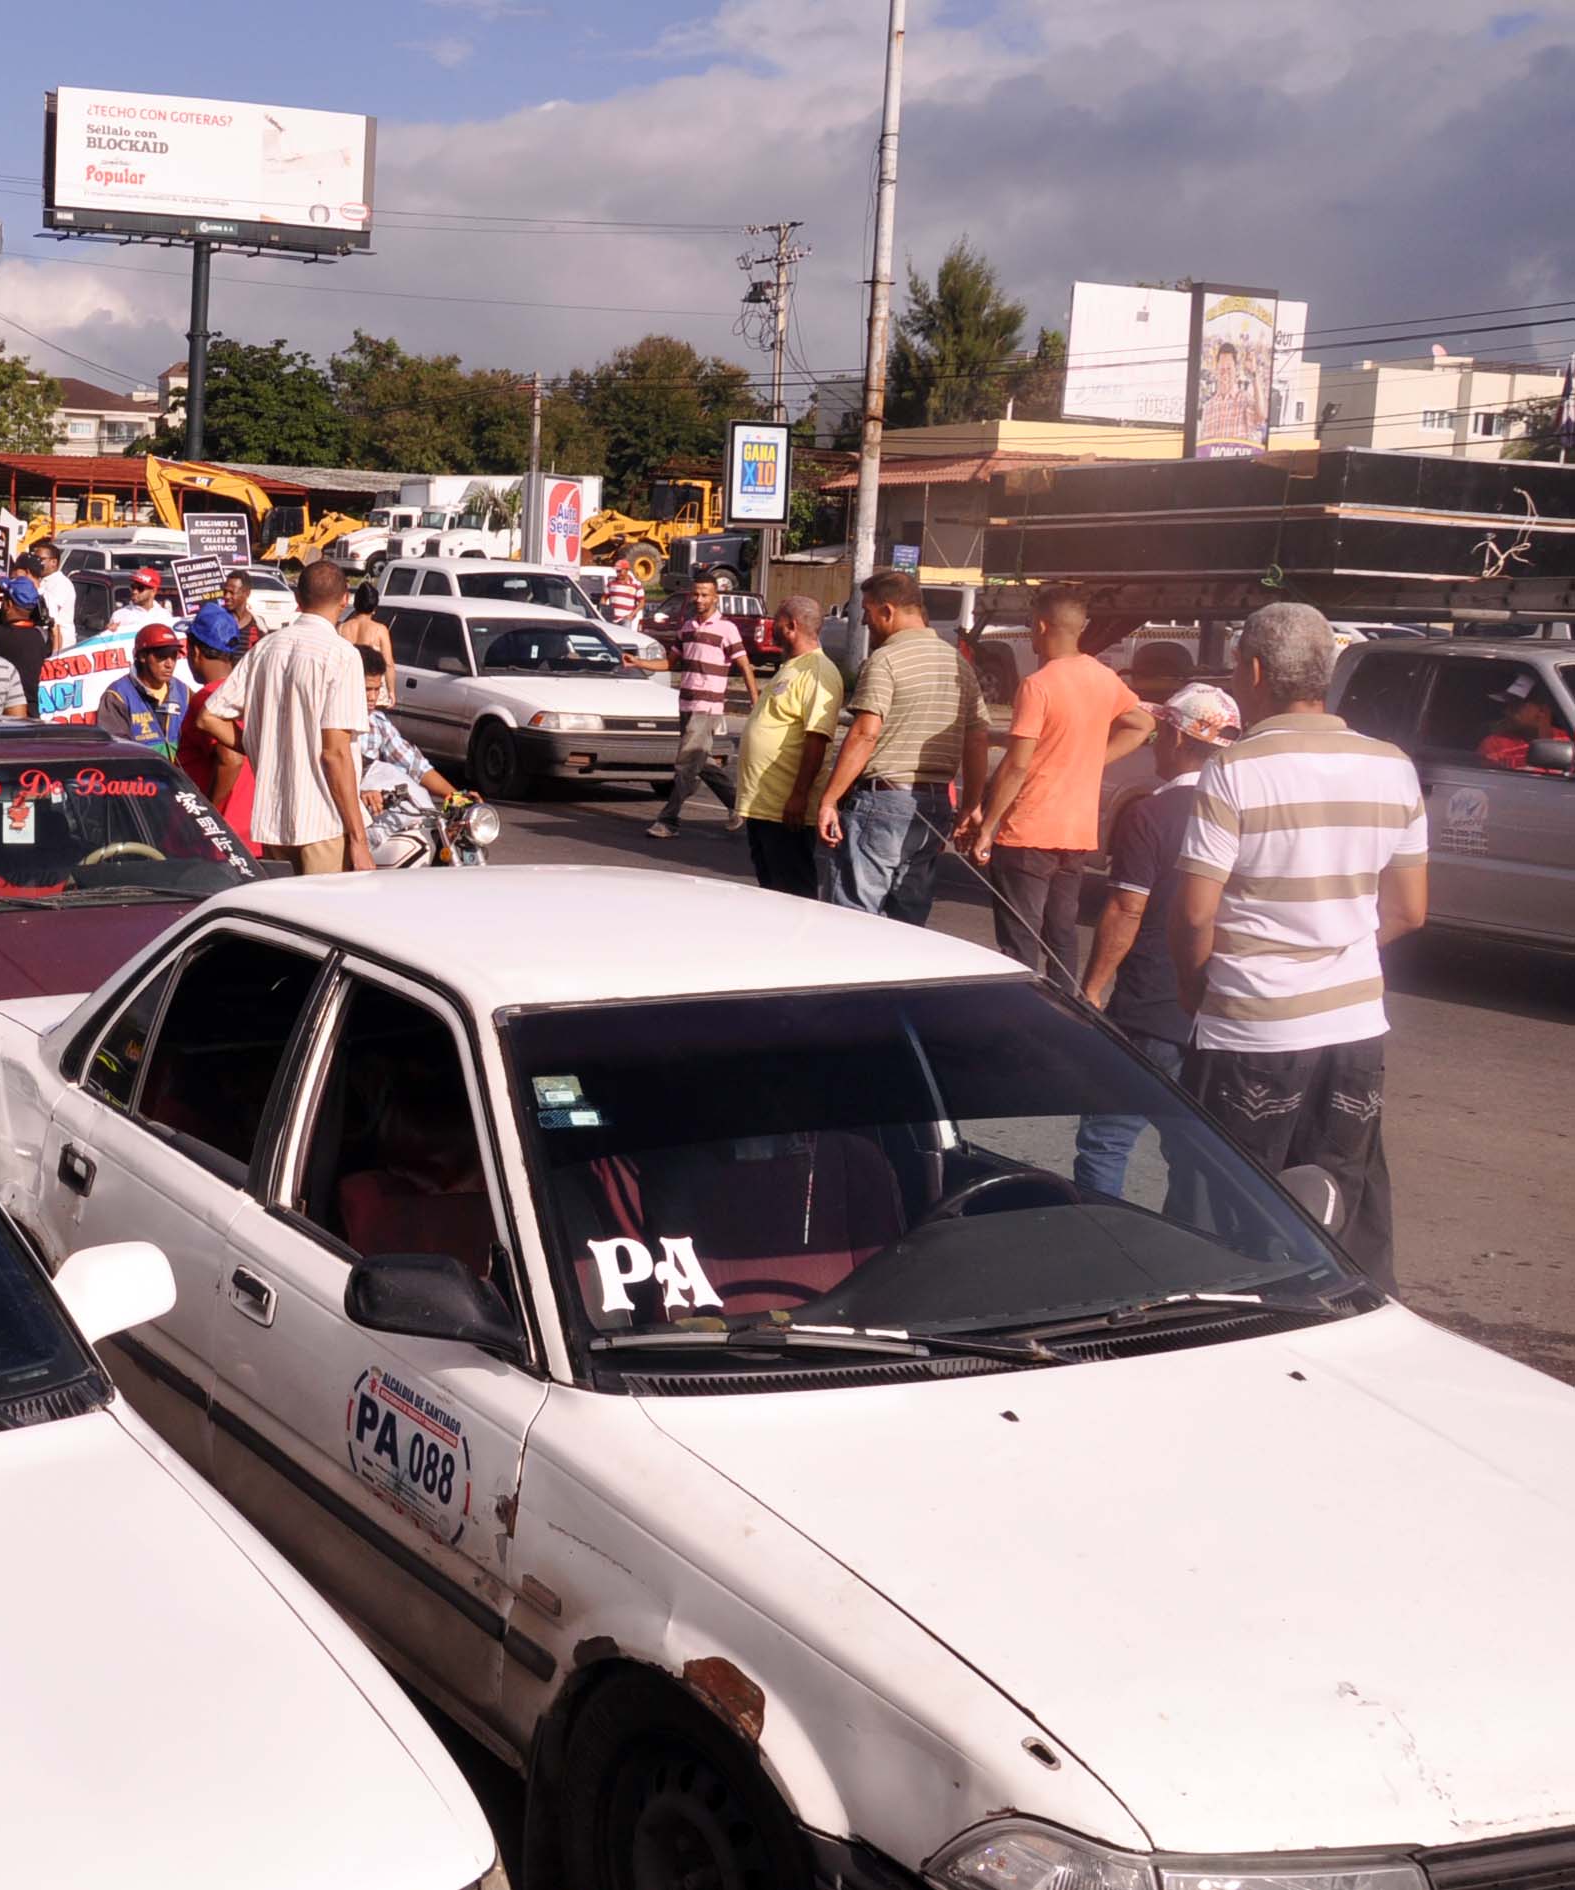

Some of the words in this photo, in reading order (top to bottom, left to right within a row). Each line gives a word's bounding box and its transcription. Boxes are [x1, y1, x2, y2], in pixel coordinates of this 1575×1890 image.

[87, 104, 136, 119] ¿TECHO
[139, 108, 167, 121] CON
[170, 111, 233, 127] GOTERAS?
[86, 137, 169, 154] BLOCKAID
[134, 129, 158, 139] con
[86, 164, 146, 187] Popular
[744, 443, 776, 461] GANA
[743, 462, 776, 488] X10
[557, 503, 576, 520] Auto
[203, 544, 238, 552] SANTIAGO
[93, 648, 130, 672] DEL
[19, 769, 63, 799] De
[75, 768, 157, 797] Barrio
[587, 1236, 724, 1313] PA
[414, 1392, 425, 1412] DE
[424, 1401, 461, 1436] SANTIAGO
[356, 1391, 400, 1469] PA
[409, 1432, 455, 1504] 088
